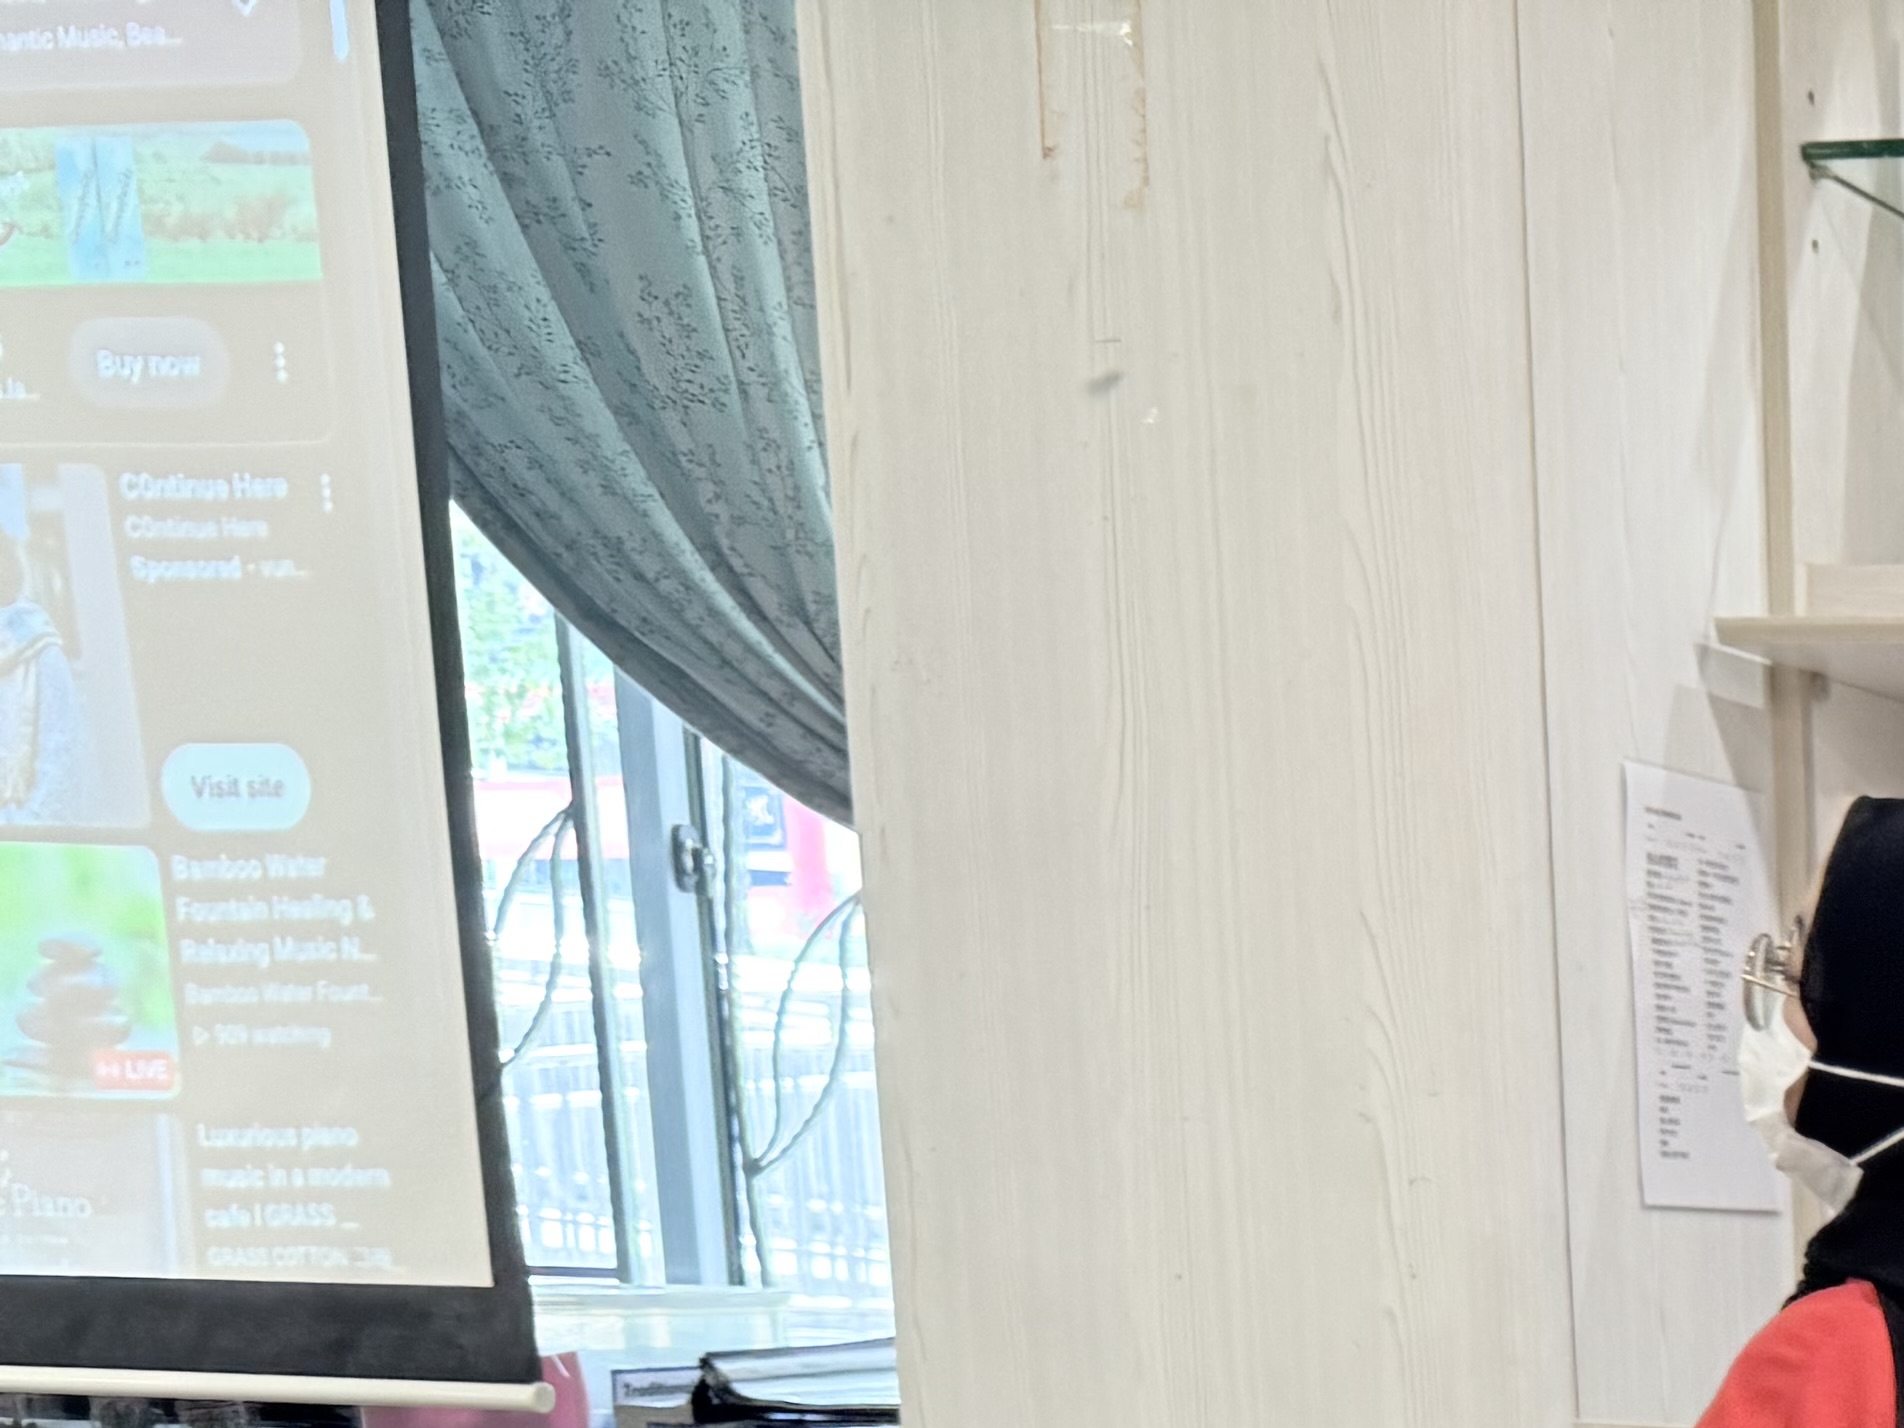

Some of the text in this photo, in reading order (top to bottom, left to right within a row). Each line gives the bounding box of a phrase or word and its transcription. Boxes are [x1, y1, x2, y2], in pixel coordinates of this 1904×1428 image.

[96, 348, 200, 384] Buy now
[232, 472, 288, 499] Here
[190, 774, 285, 799] Visit site
[170, 852, 262, 881] Bamboo
[272, 935, 338, 962] Music
[125, 1059, 168, 1079] LIVE
[301, 1121, 359, 1151] piano
[201, 1163, 265, 1188] music
[306, 1163, 390, 1188] modern
[11, 1183, 92, 1217] Piano
[264, 1203, 336, 1228] GRASS
